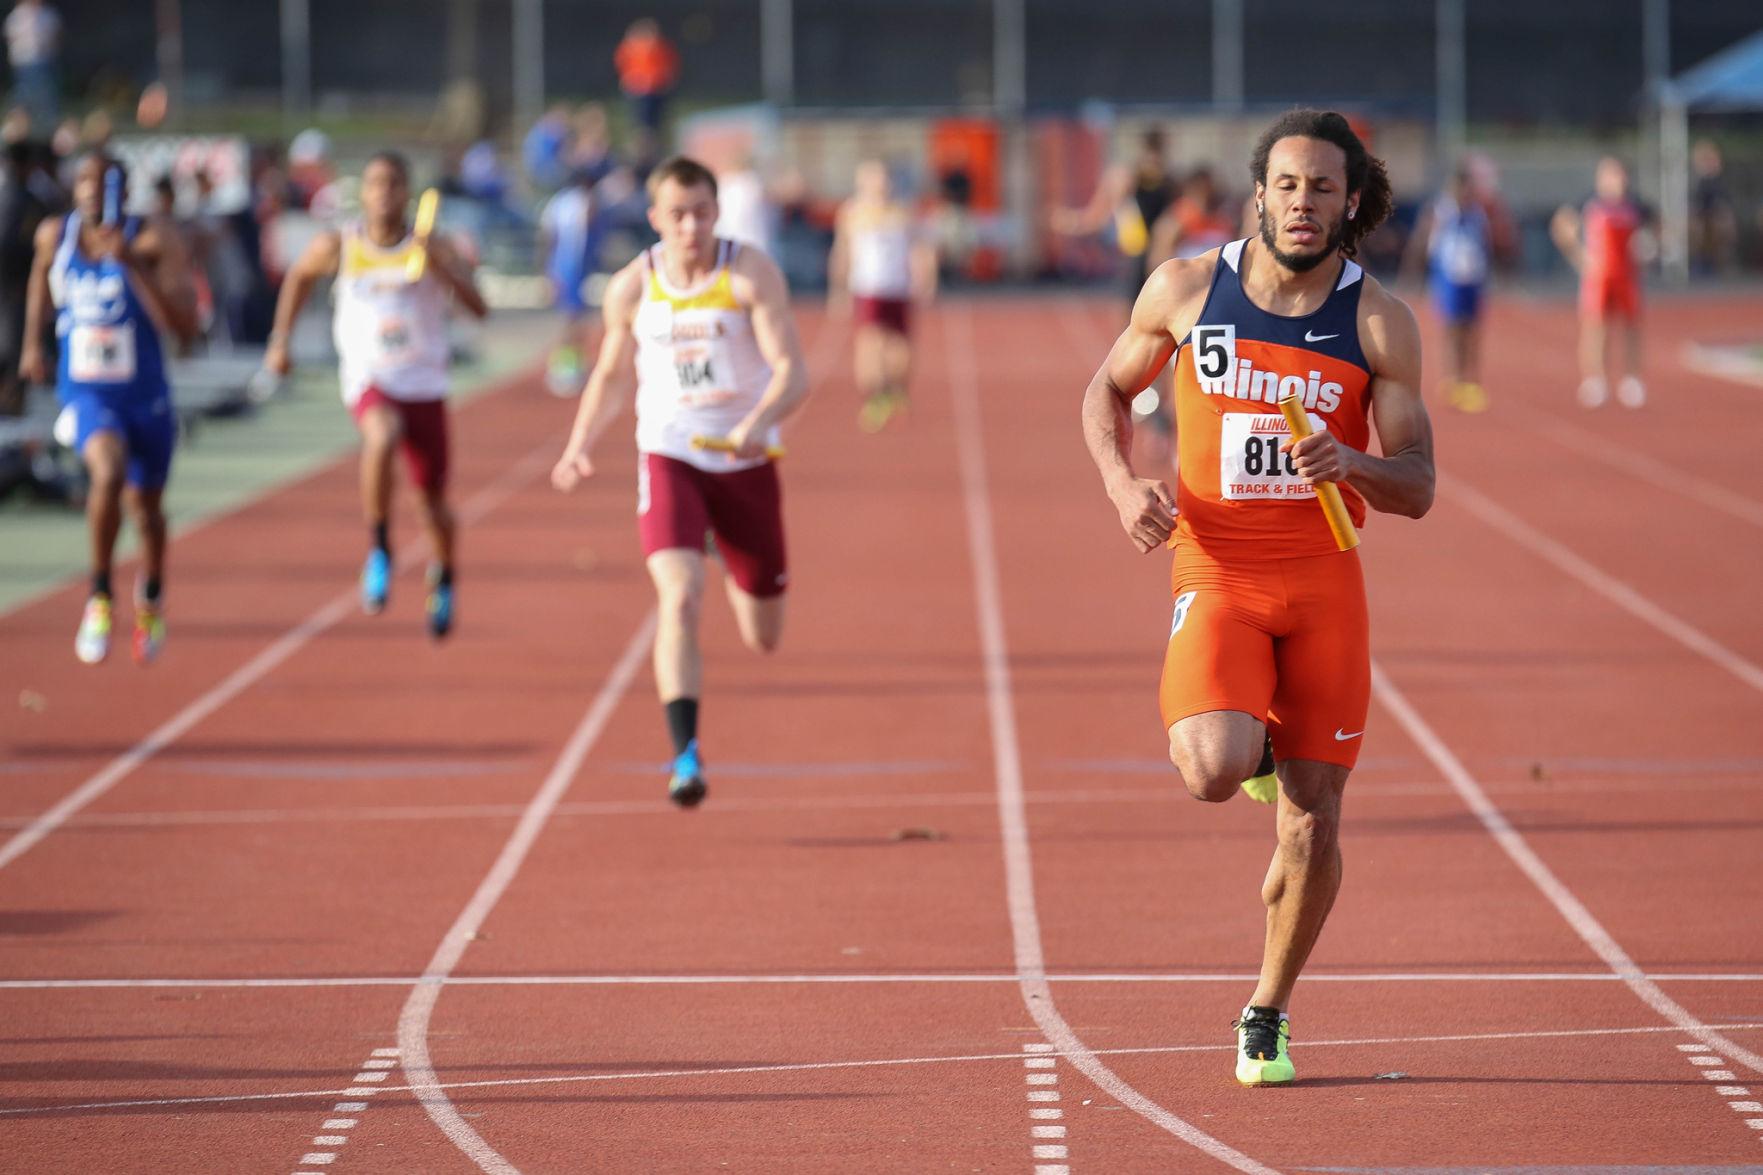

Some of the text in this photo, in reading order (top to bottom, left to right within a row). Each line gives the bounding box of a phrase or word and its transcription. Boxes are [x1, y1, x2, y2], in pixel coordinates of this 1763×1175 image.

[1199, 328, 1229, 379] 5
[1229, 483, 1270, 495] TRACK
[1273, 483, 1284, 494] &
